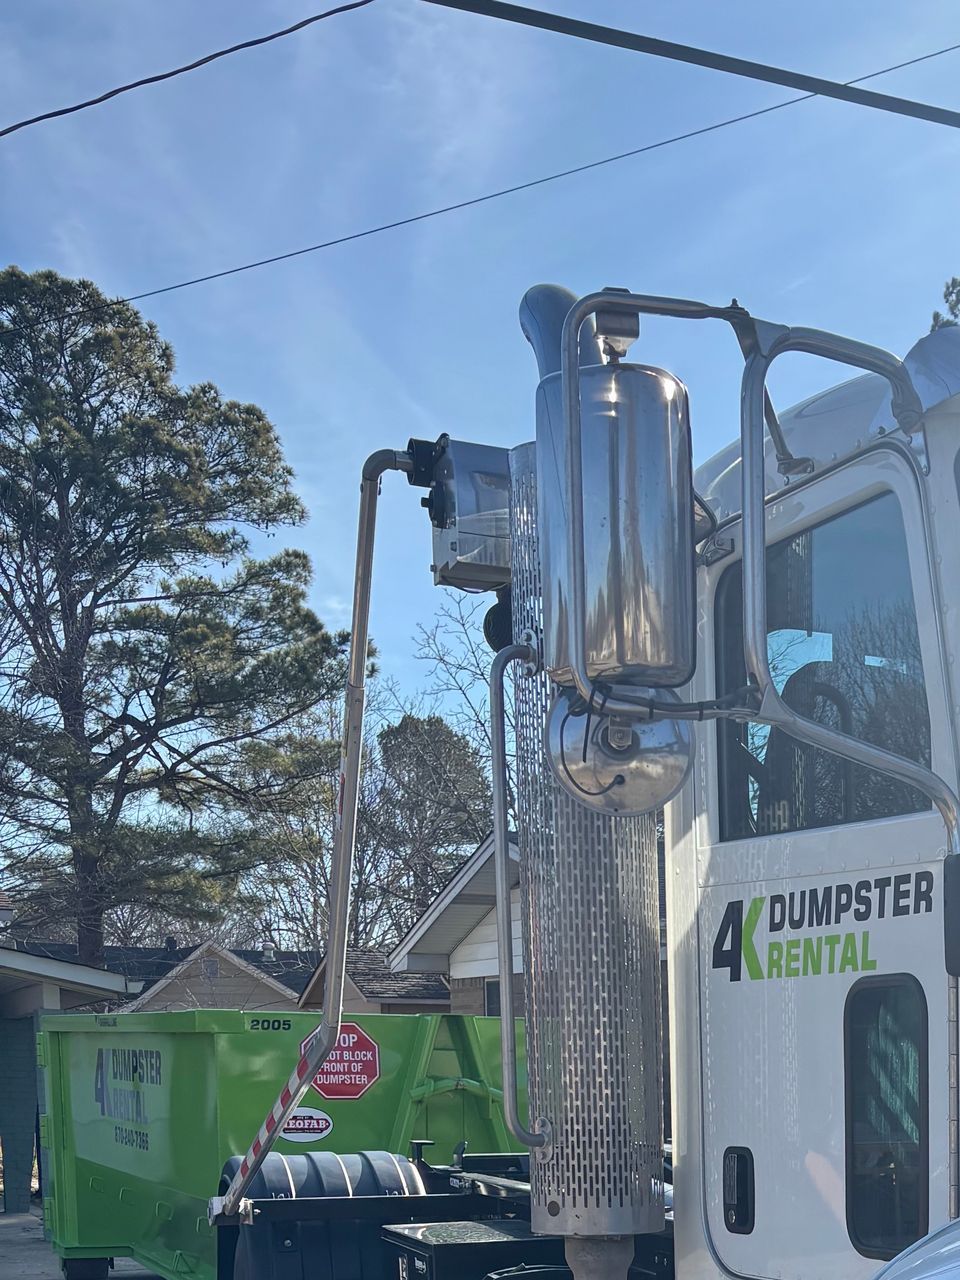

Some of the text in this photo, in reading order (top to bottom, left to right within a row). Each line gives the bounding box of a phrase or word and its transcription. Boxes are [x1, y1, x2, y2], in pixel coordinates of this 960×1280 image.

[712, 870, 934, 982] 4K DUMPSTER
[767, 931, 877, 979] RENTAL
[250, 1019, 292, 1031] 2005
[343, 1051, 373, 1061] BLOCK
[351, 1062, 364, 1072] OF
[95, 1047, 162, 1118] 4K DUMPSTER
[317, 1074, 368, 1084] DUMPSTER
[113, 1087, 149, 1126] RENTAL
